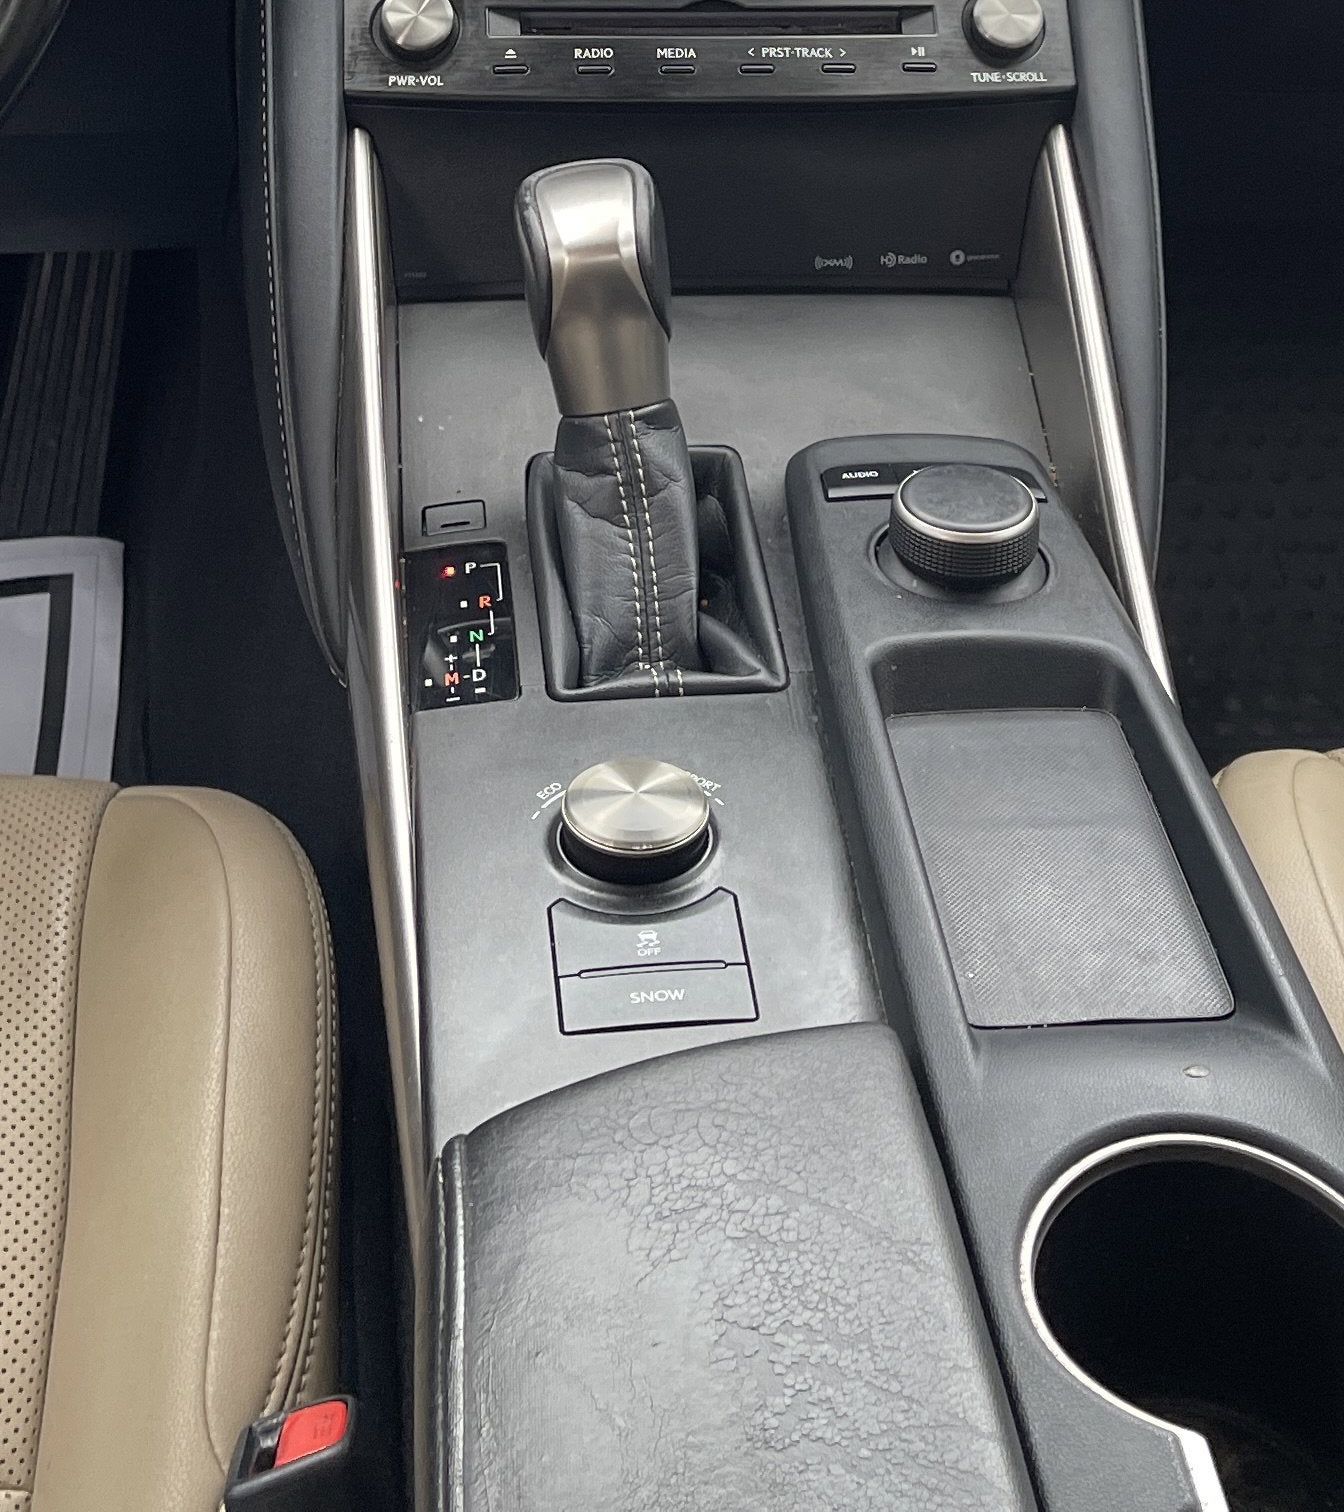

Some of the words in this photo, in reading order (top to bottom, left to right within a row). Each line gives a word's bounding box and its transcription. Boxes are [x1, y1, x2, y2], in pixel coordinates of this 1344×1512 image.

[574, 48, 614, 59] RADIO
[656, 48, 697, 59] MEDIA
[898, 254, 928, 265] Radio
[841, 470, 879, 479] AUDIO
[465, 562, 477, 574] P
[479, 595, 492, 608] R
[469, 629, 484, 642] N
[444, 672, 460, 687] M
[472, 669, 487, 682] D
[536, 782, 562, 800] ECO
[637, 947, 661, 956] OFF
[630, 989, 685, 1004] SNOW
